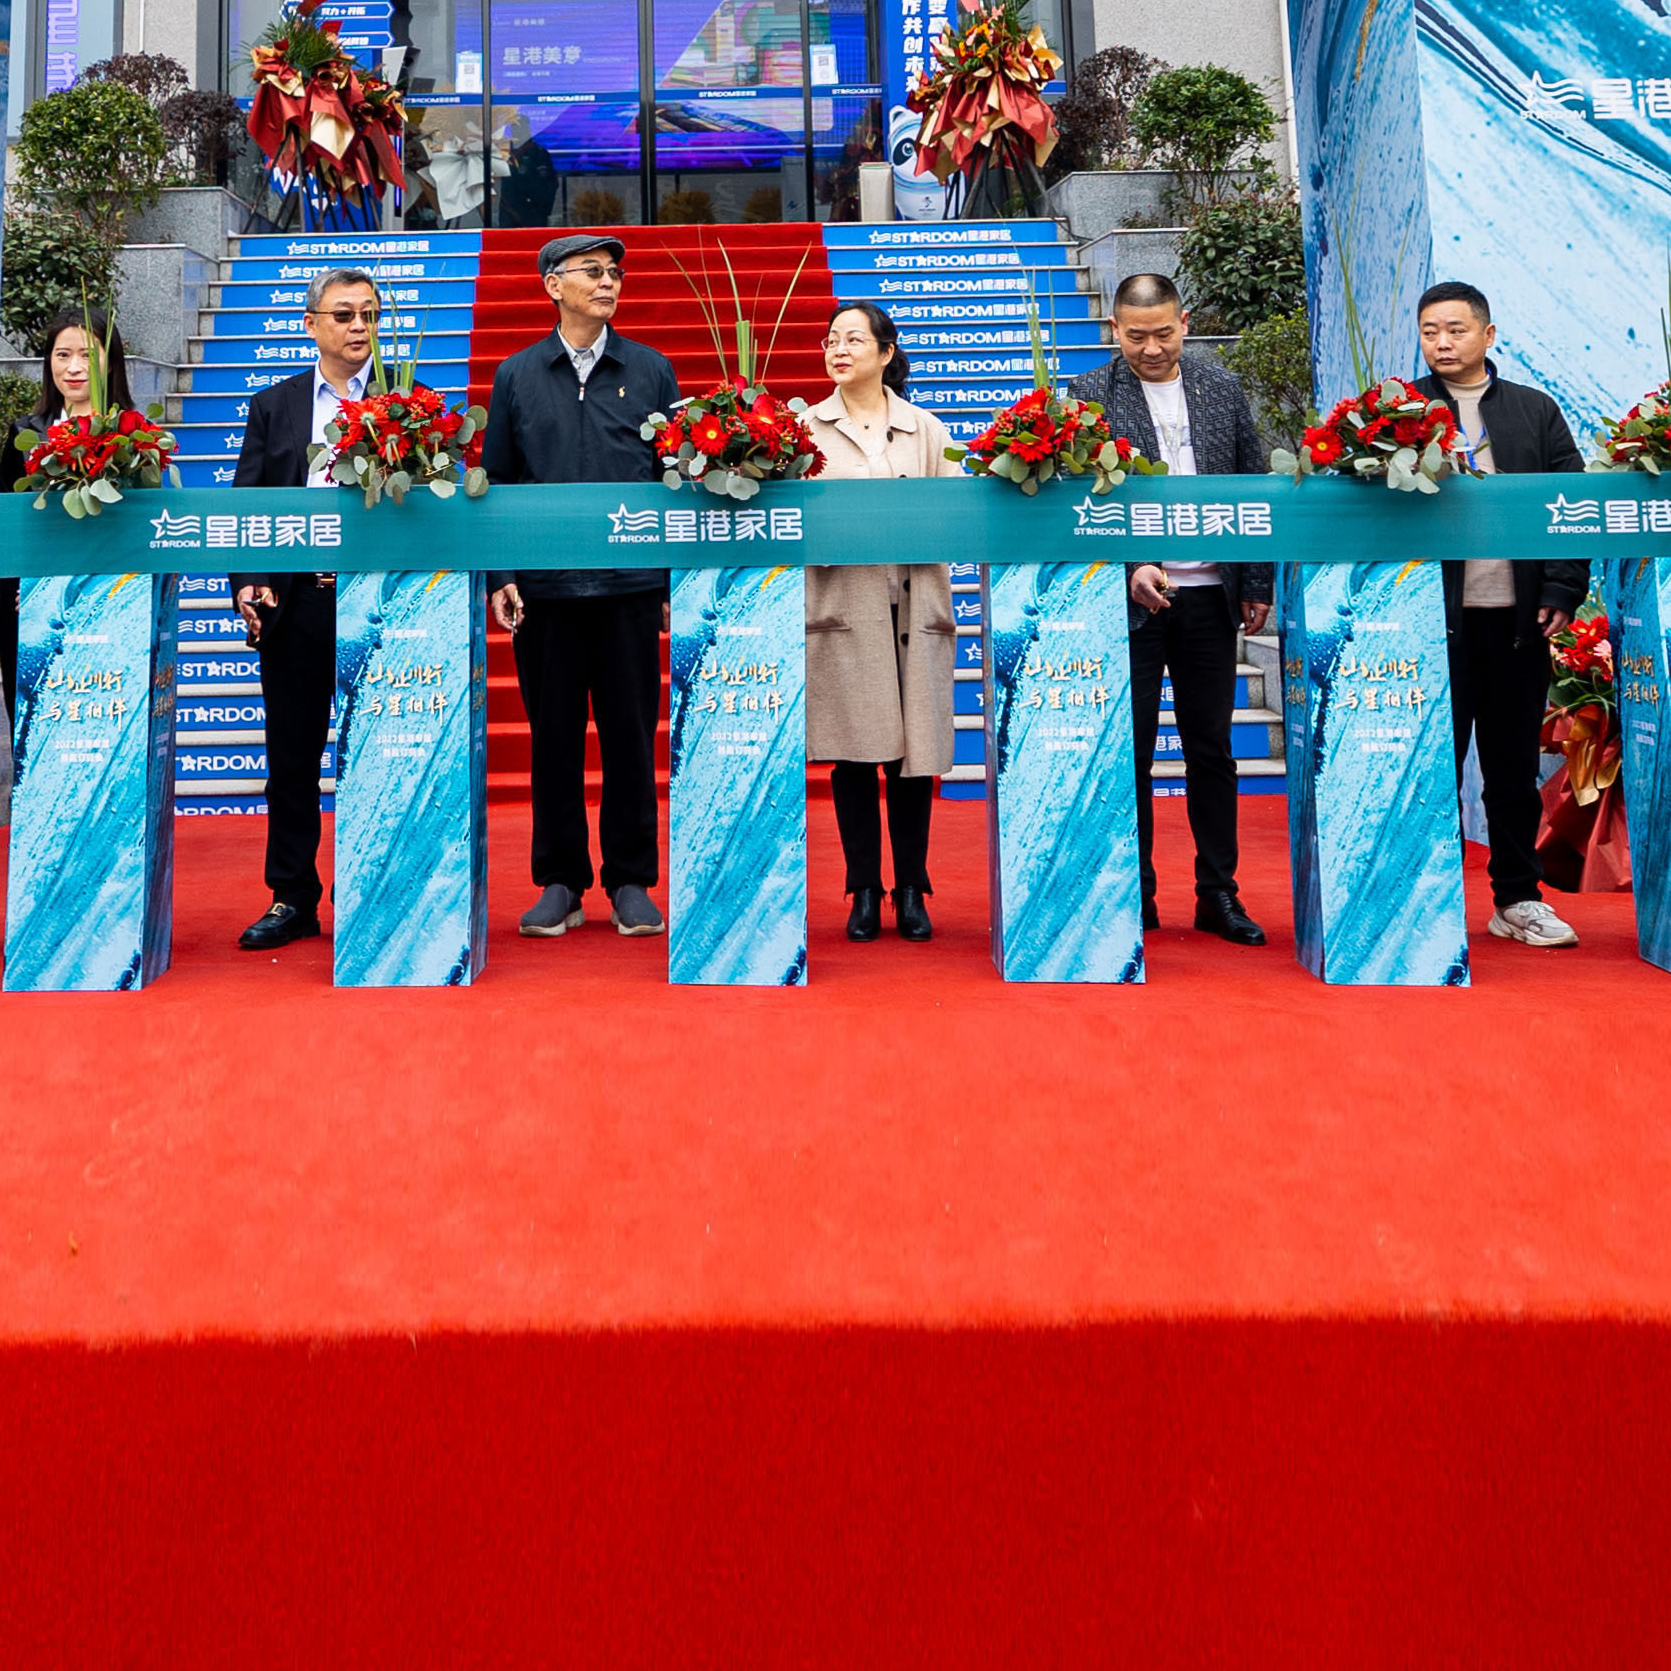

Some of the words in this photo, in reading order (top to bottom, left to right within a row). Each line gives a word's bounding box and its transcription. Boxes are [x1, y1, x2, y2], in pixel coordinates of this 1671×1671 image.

[1131, 502, 1272, 536] 星港家居
[665, 507, 803, 543] 星港家居
[1547, 525, 1601, 534] STARDOM
[206, 514, 342, 549] 星港家居
[1073, 527, 1126, 536] STARDOM
[608, 534, 660, 543] STARDOM
[150, 540, 201, 549] STARDOM
